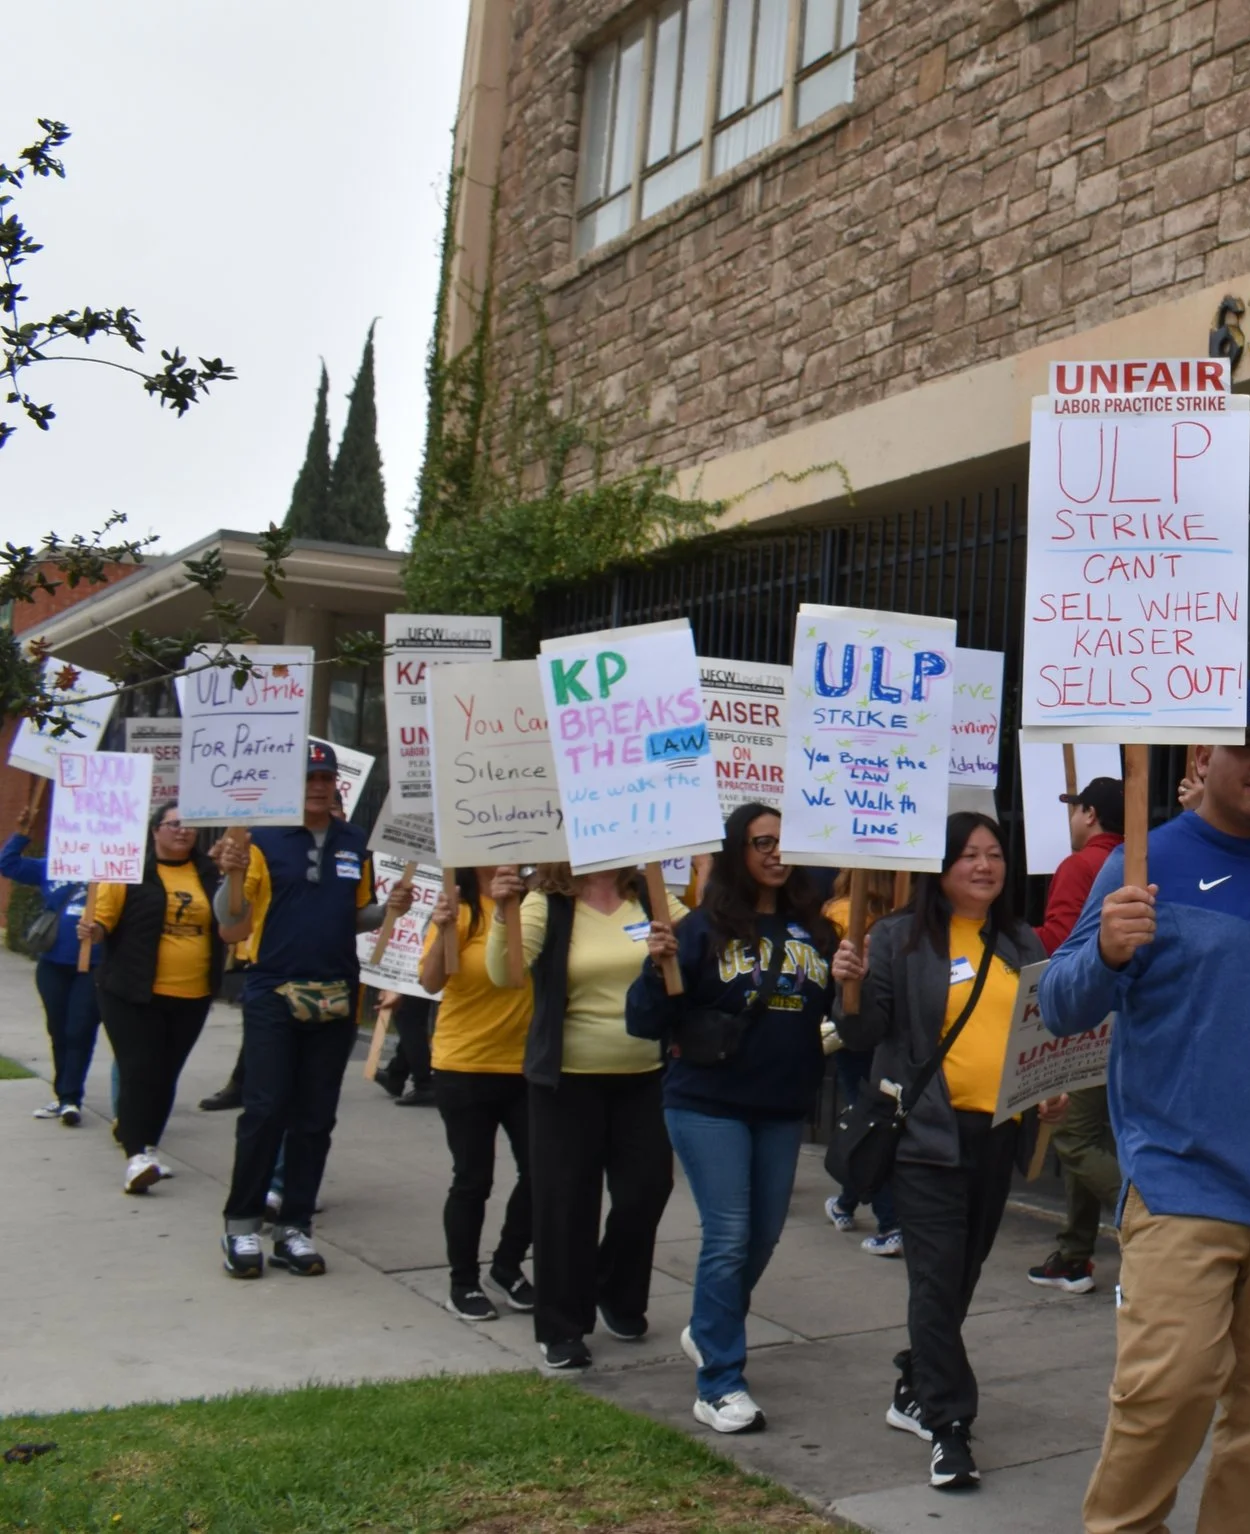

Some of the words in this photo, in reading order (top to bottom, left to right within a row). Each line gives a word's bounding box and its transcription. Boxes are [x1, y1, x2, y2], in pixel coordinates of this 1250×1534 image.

[1056, 361, 1226, 395] UNFAIR
[1054, 399, 1100, 415] LABOR
[1104, 396, 1173, 414] PRACTICE
[1176, 396, 1226, 412] STRIKE
[1058, 421, 1212, 505] ULP
[1051, 508, 1219, 542] STRIKE
[1083, 553, 1182, 585] CAN'T
[1033, 592, 1123, 622] SELL
[1137, 591, 1239, 623] WHEN
[408, 627, 444, 641] UFCW
[1073, 628, 1195, 658] KAISER
[245, 667, 304, 706] Strike
[550, 651, 628, 706] KP
[701, 668, 736, 683] UFCW
[815, 641, 951, 704] ULP
[1036, 664, 1153, 708] SELLS
[954, 682, 995, 699] rve
[454, 694, 504, 741] You
[514, 706, 549, 733] Ca
[560, 687, 702, 741] BREAKS
[703, 698, 782, 728] AISER
[813, 708, 908, 729] STRIKE
[191, 727, 226, 764] FOR
[565, 734, 643, 774] THE
[650, 731, 705, 757] LAW
[708, 732, 774, 747] EMPLOYEES
[732, 746, 752, 761] ON
[454, 751, 548, 784] Silence
[715, 760, 785, 784] NFAIR
[803, 747, 830, 770] You
[840, 751, 889, 769] Break
[896, 753, 927, 770] the
[607, 775, 657, 798] walk
[665, 772, 701, 790] the
[724, 780, 760, 793] PRACTICE
[850, 770, 889, 783] LAW
[152, 785, 180, 797] FAIR
[802, 787, 836, 807] We
[844, 789, 895, 811] Walk
[454, 799, 564, 830] Solidarity
[574, 816, 621, 839] line
[853, 817, 899, 837] LINE
[55, 836, 90, 854] We
[53, 858, 82, 875] the
[374, 874, 437, 906] KSE
[1018, 1023, 1110, 1066] UNFAI
[1095, 1037, 1112, 1049] STR
